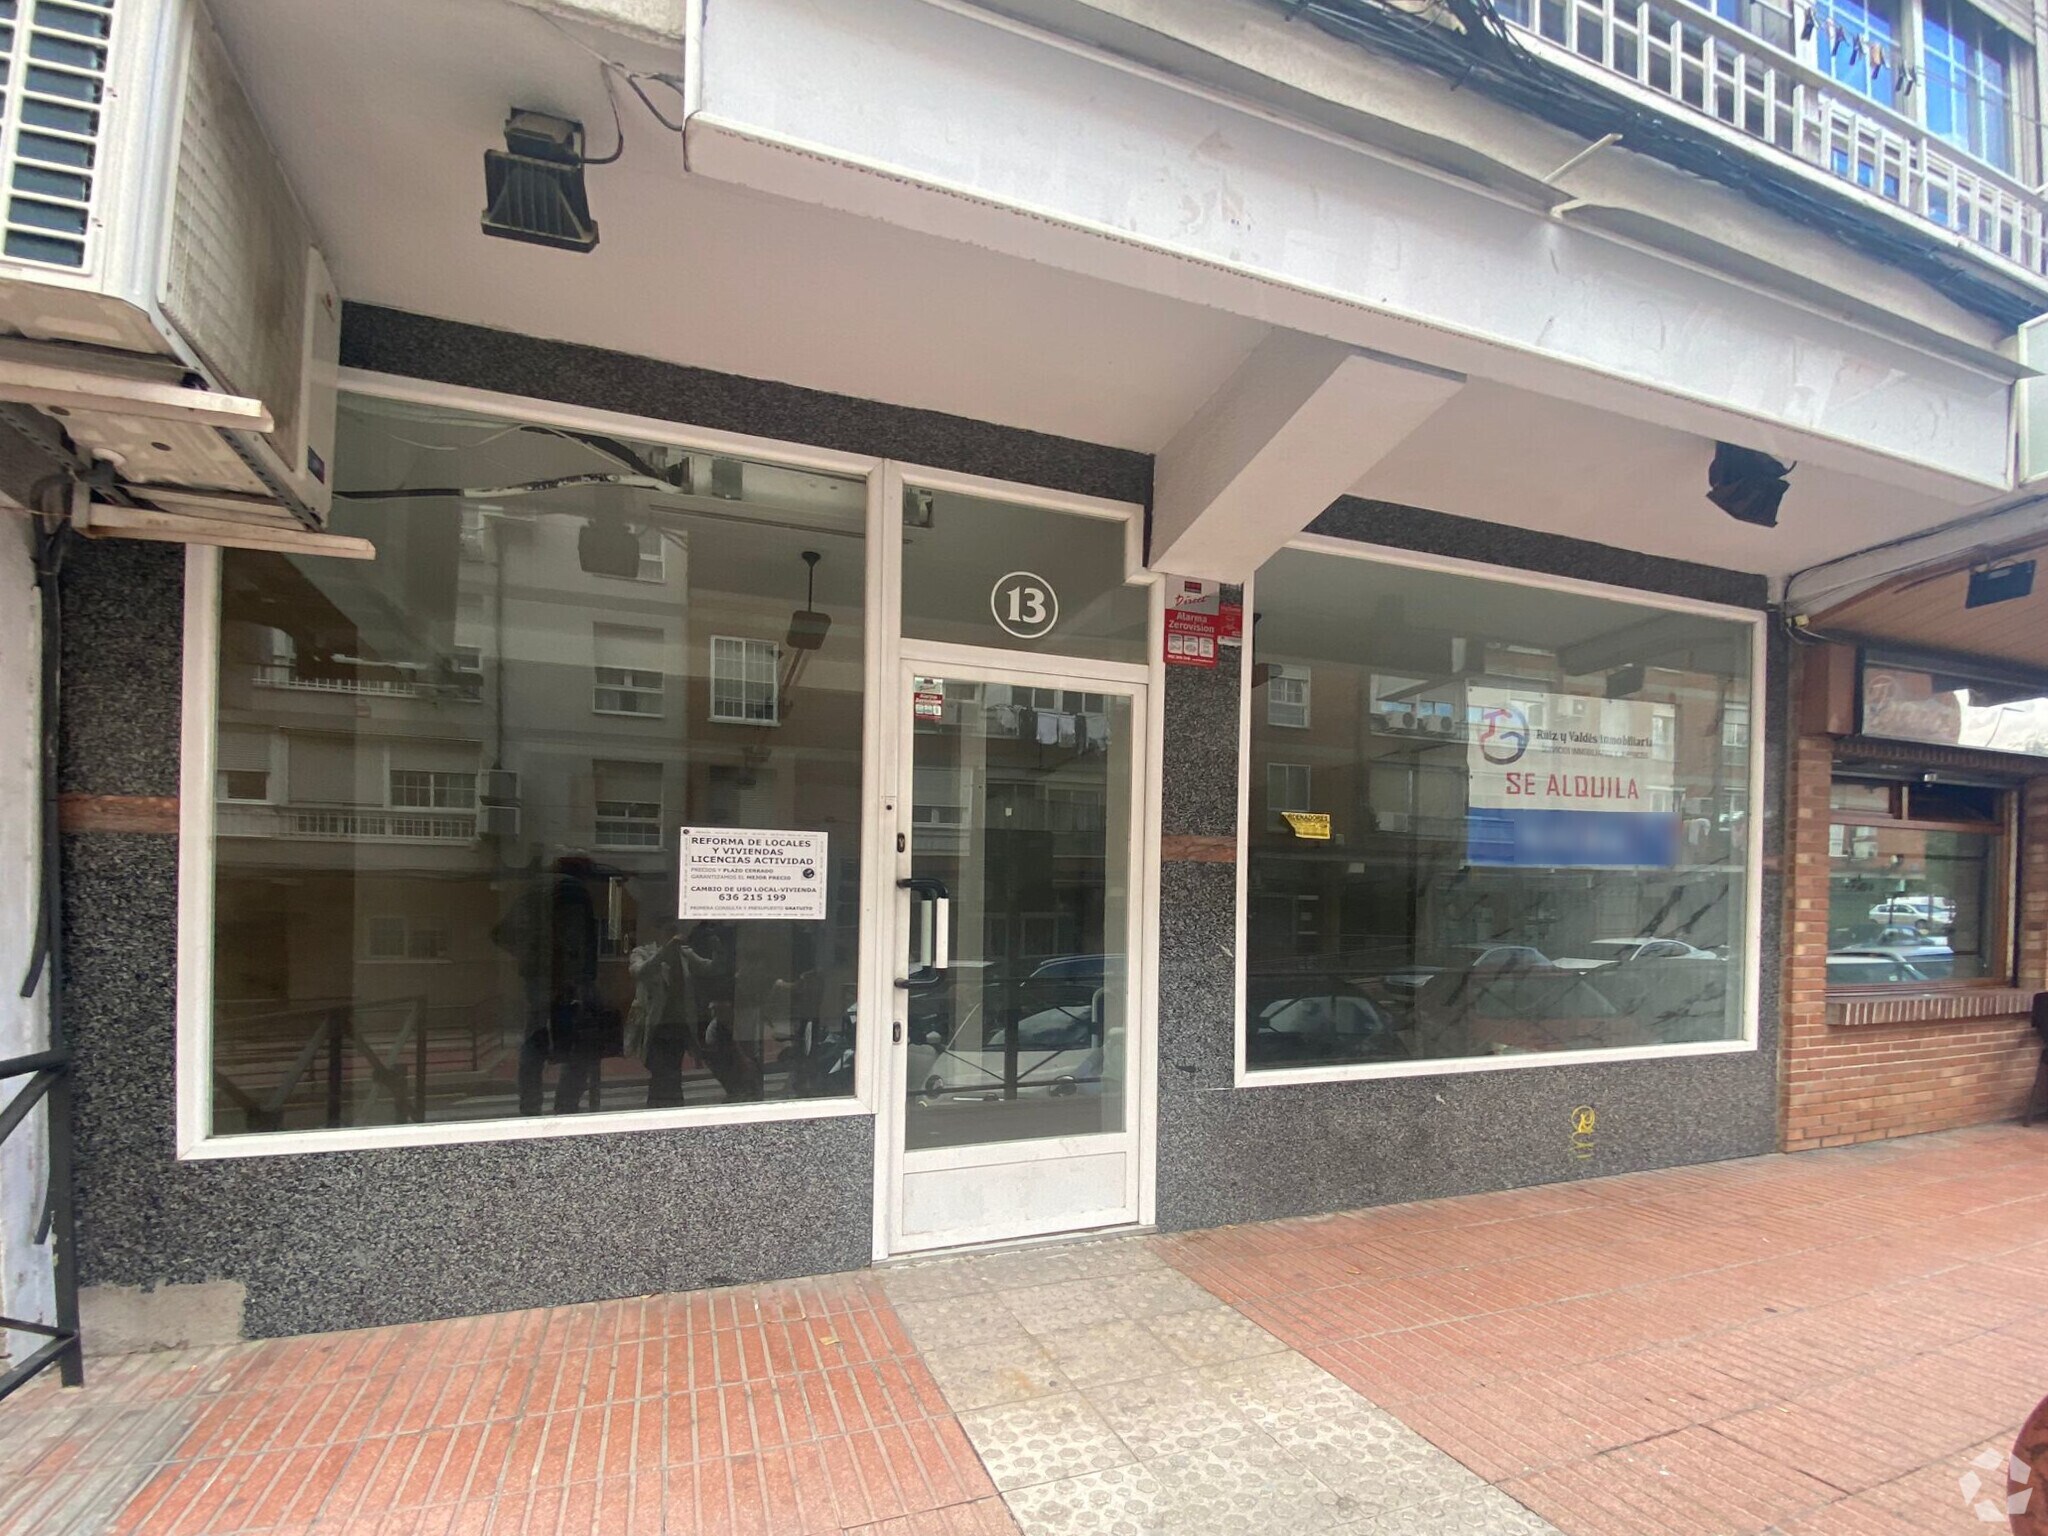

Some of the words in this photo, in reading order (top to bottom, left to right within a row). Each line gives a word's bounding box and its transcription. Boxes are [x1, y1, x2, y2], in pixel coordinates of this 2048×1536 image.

[1007, 586, 1046, 623] 13
[1177, 612, 1208, 623] Alarma
[1168, 620, 1215, 633] Zerovision
[1536, 730, 1558, 741] Ruiz
[1560, 732, 1567, 744] y
[1506, 772, 1536, 795] SE
[1546, 774, 1639, 799] ALQUILA
[691, 837, 744, 846] REFORMA
[748, 838, 762, 846] DE
[765, 839, 811, 848] LOCALES
[712, 847, 720, 855] Y
[722, 847, 784, 856] VIVIENDAS
[691, 855, 751, 864] LICENCIAS
[754, 857, 814, 865] ACTIVIDAD
[718, 893, 739, 901] 636
[742, 893, 763, 901] 215
[767, 893, 787, 902] 199
